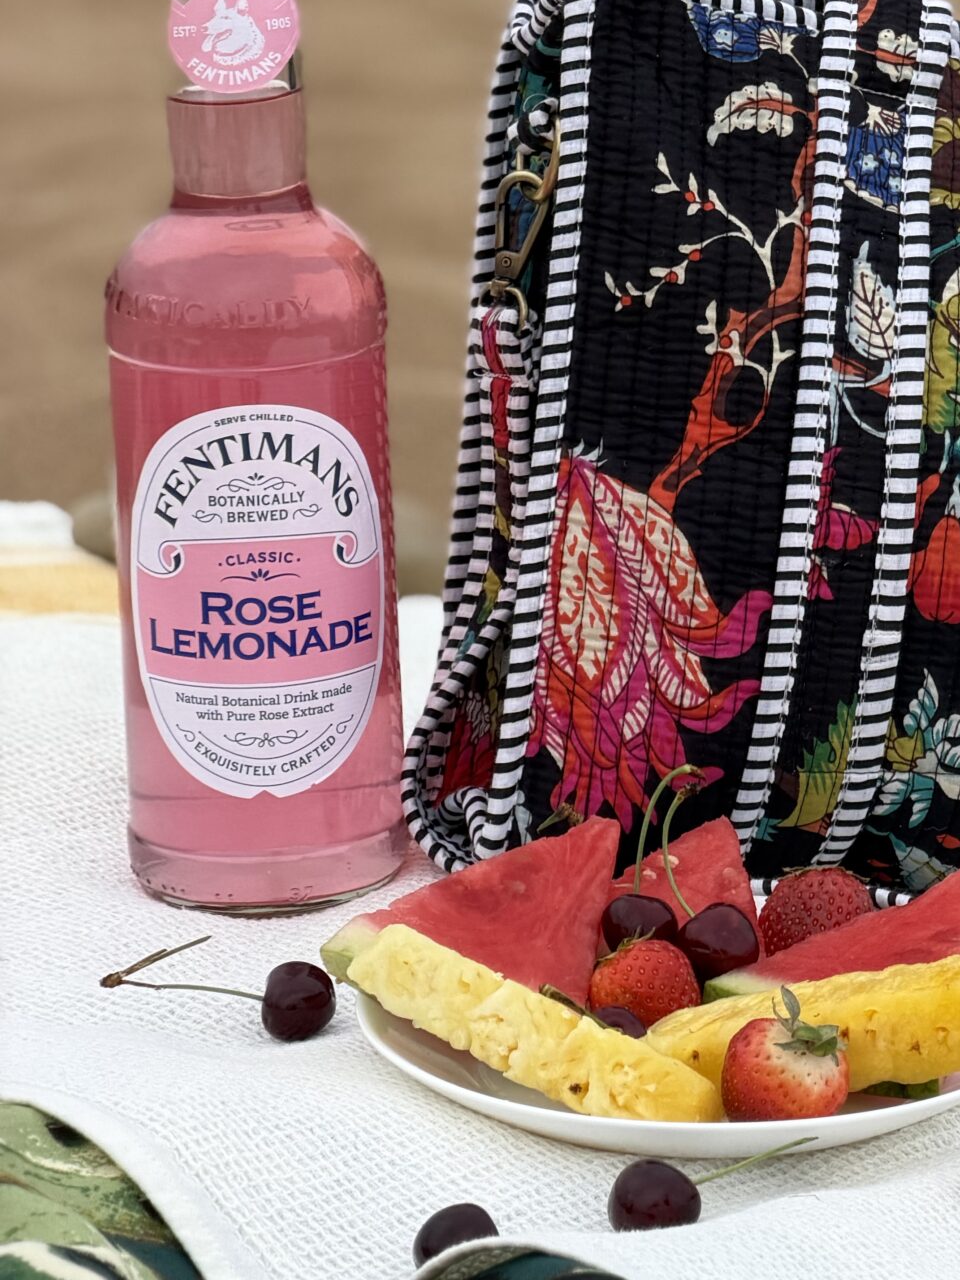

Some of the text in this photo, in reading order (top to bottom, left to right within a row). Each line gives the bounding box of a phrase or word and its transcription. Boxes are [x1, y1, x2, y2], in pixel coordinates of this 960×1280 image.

[265, 17, 291, 30] 1905
[187, 51, 282, 86] FENTIMANS
[214, 413, 294, 428] SERVE CHILLED
[154, 431, 360, 528] FENTIMANS
[208, 490, 305, 508] BOTANICALLY
[226, 509, 289, 523] BREWED
[225, 552, 295, 567] CLASSIC
[200, 590, 322, 625] ROSE
[149, 611, 373, 660] LEMONADE
[175, 683, 353, 708] Natural Botanical Drink made
[196, 702, 335, 721] with Pure Rose Extract
[194, 735, 337, 777] EXQUISITELY CRAFTED
